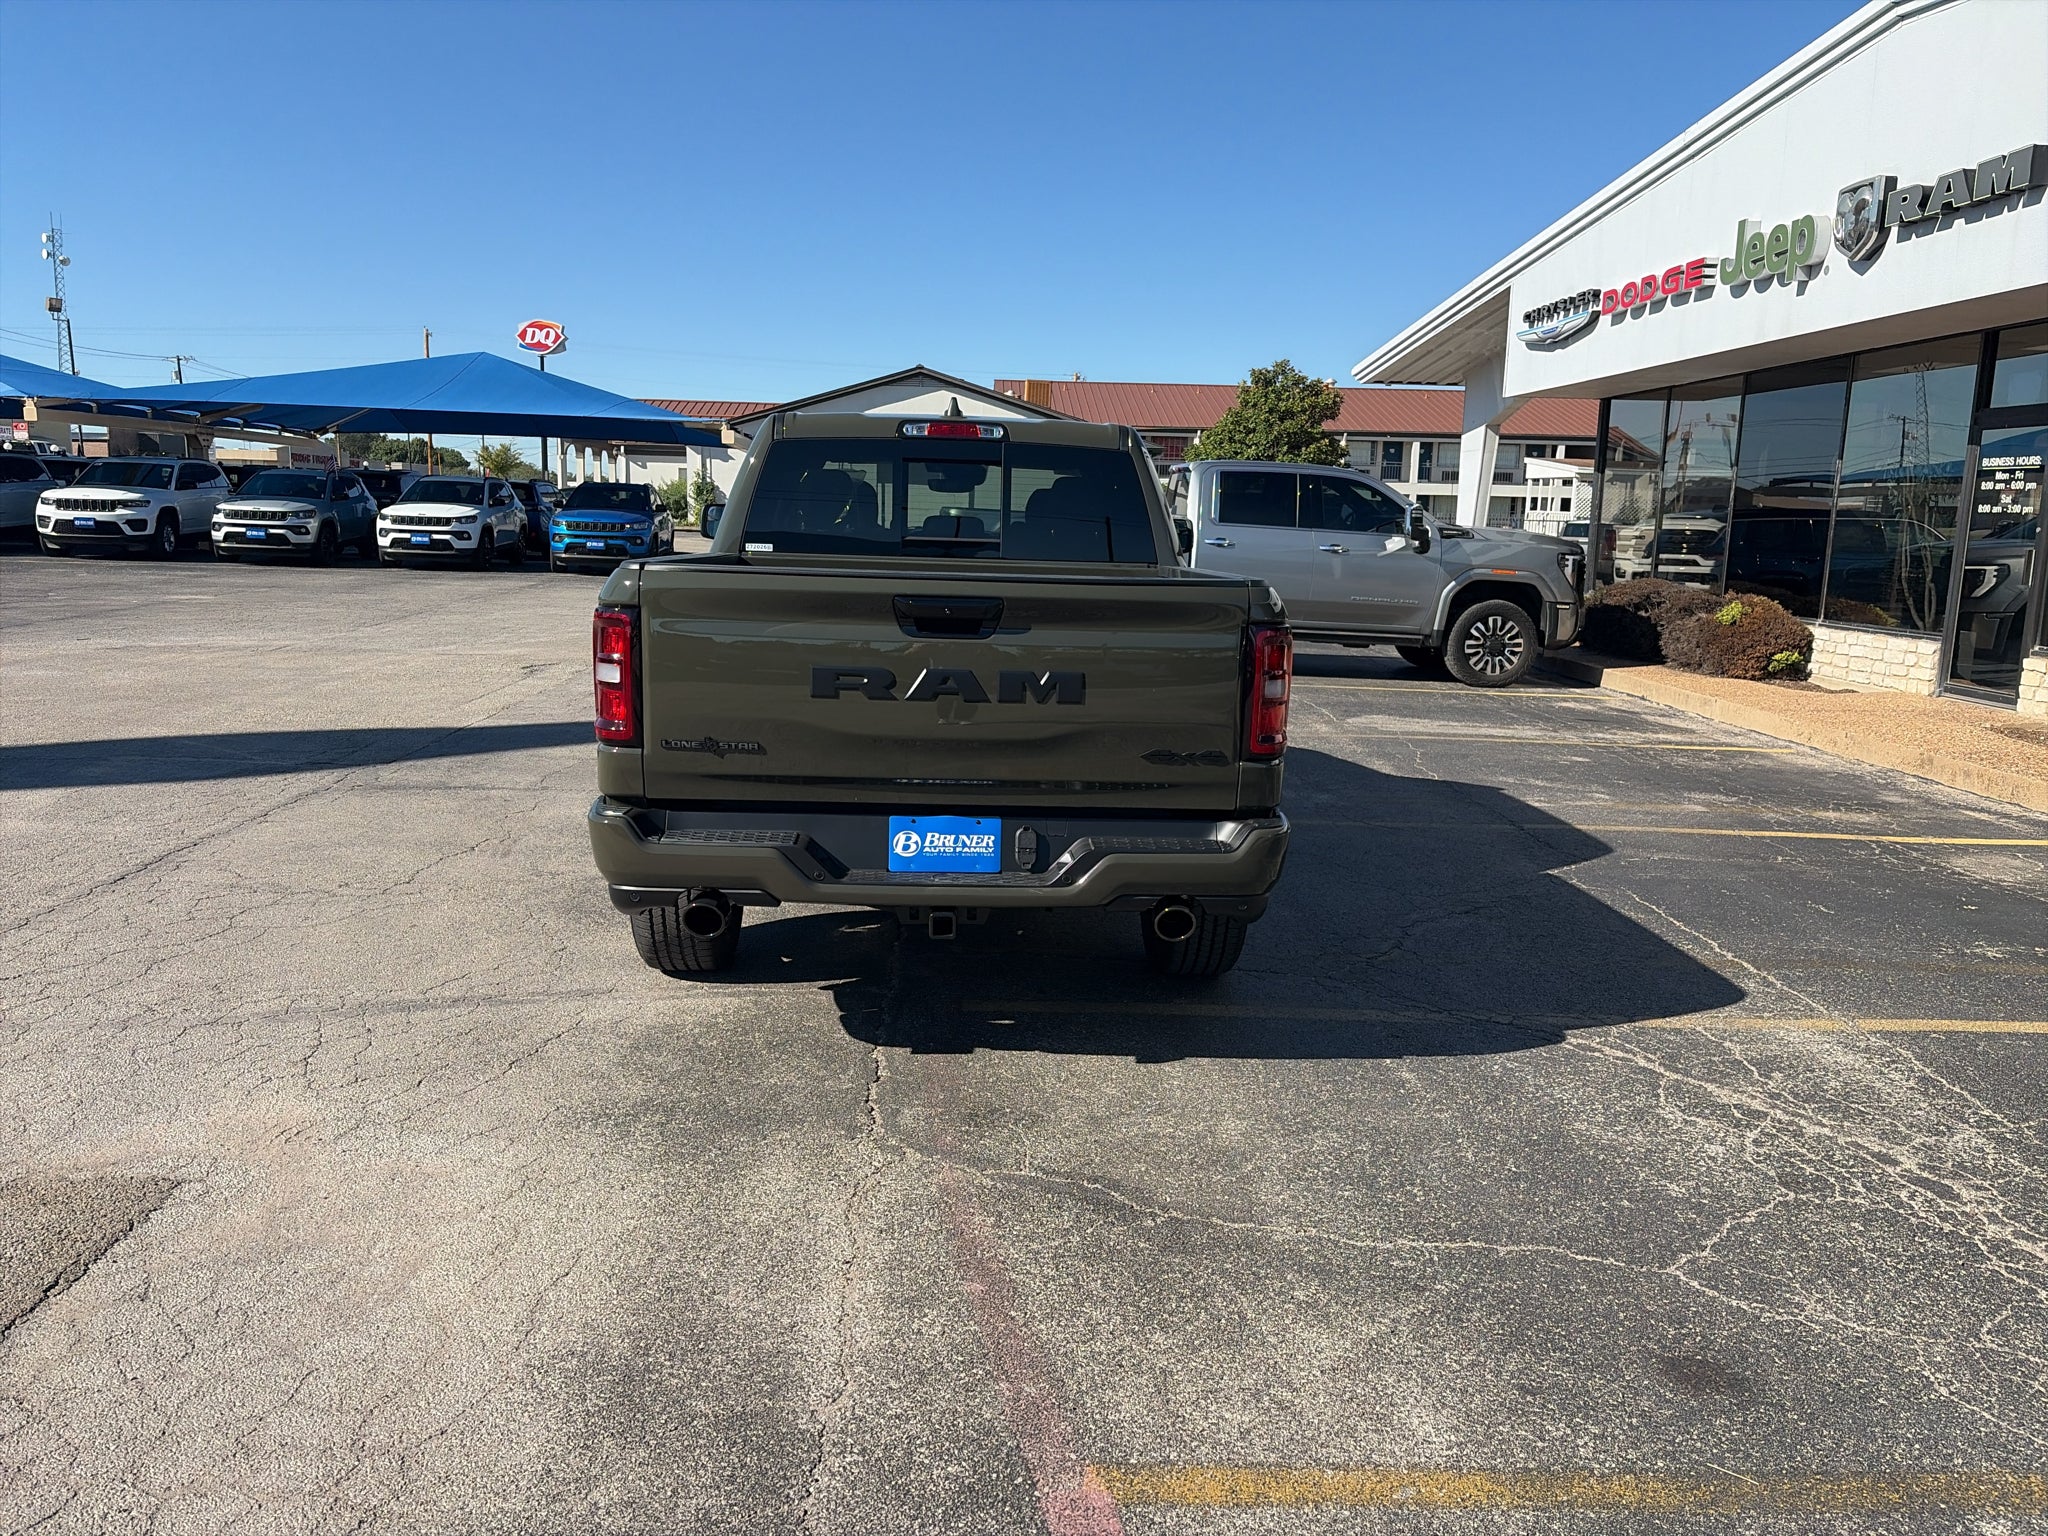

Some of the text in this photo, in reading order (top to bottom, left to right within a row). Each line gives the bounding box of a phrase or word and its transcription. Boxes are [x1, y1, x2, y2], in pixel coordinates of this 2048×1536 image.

[1885, 143, 2036, 228] RAM
[1720, 214, 1817, 285] Jeep
[1601, 257, 1707, 316] DODGE
[1523, 289, 1599, 324] CHRYSLER
[524, 327, 556, 347] DQ
[1982, 456, 2042, 467] BUSINESS HOURS:
[1995, 471, 2010, 480] Mon
[2015, 471, 2024, 480] Fri
[1981, 482, 1994, 490] 8:00
[2011, 481, 2024, 490] 6:00
[2025, 482, 2037, 491] pm
[2001, 495, 2012, 504] Sat
[1978, 504, 1991, 513] 8:00
[2007, 505, 2021, 513] 3:00
[2022, 506, 2034, 515] pm
[809, 665, 1086, 706] RAM
[661, 740, 760, 751] LONE STAR
[924, 833, 995, 847] BRUNER
